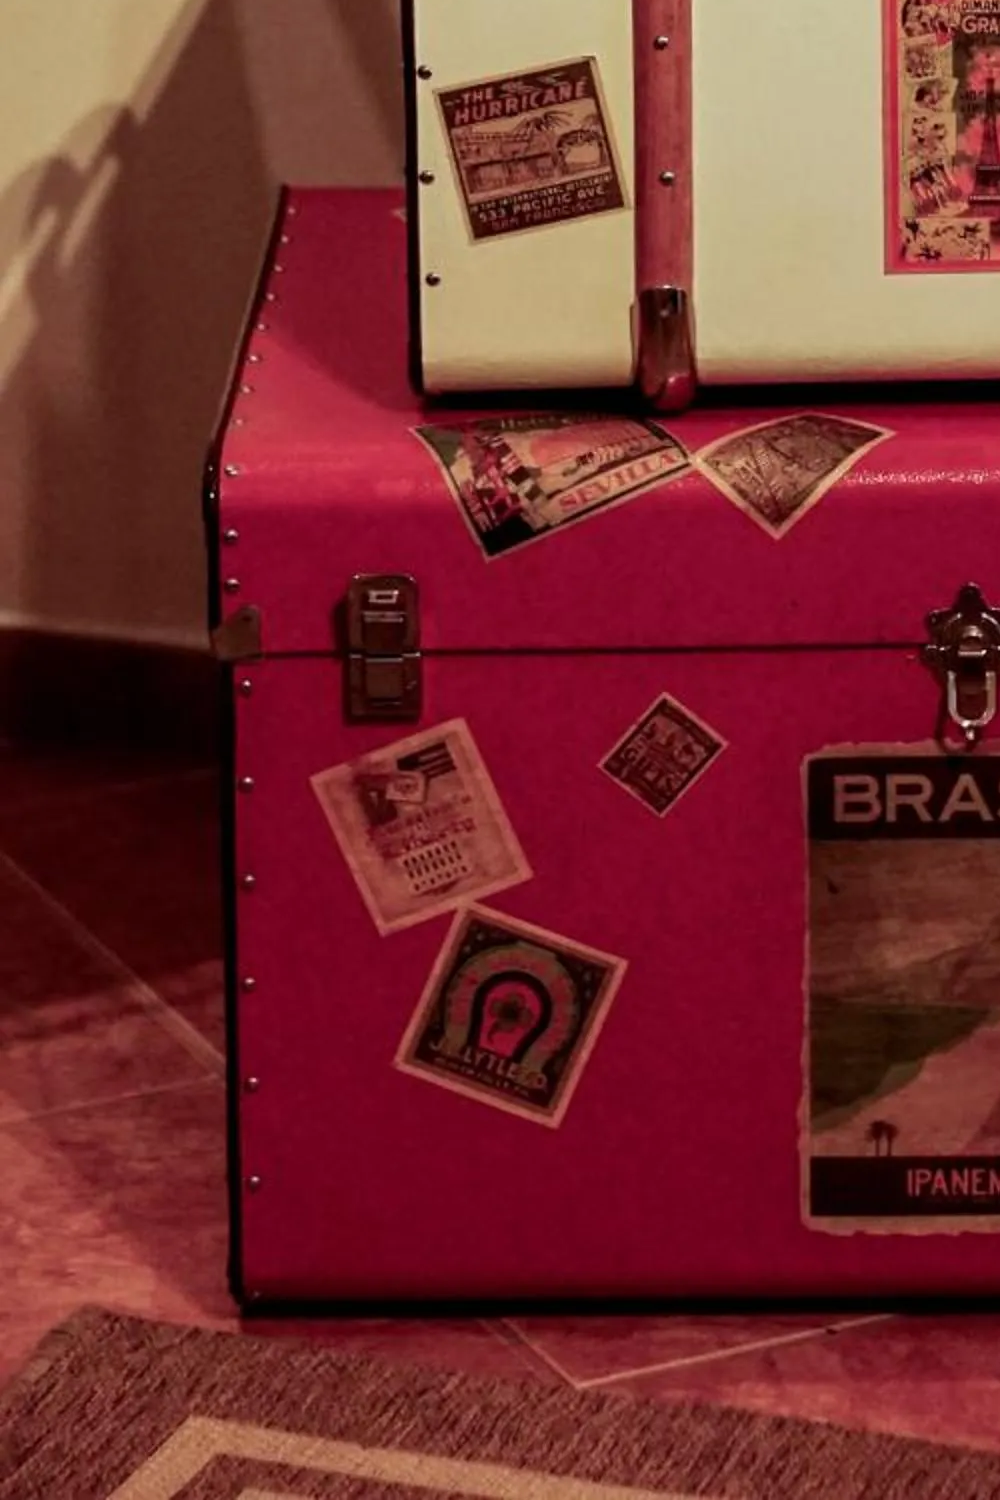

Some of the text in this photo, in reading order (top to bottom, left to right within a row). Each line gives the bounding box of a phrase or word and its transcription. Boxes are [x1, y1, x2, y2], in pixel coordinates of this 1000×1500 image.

[453, 75, 590, 126] HURRICANE
[461, 87, 495, 105] THE
[512, 193, 571, 217] PACIFIC
[558, 452, 681, 512] SEVILLA
